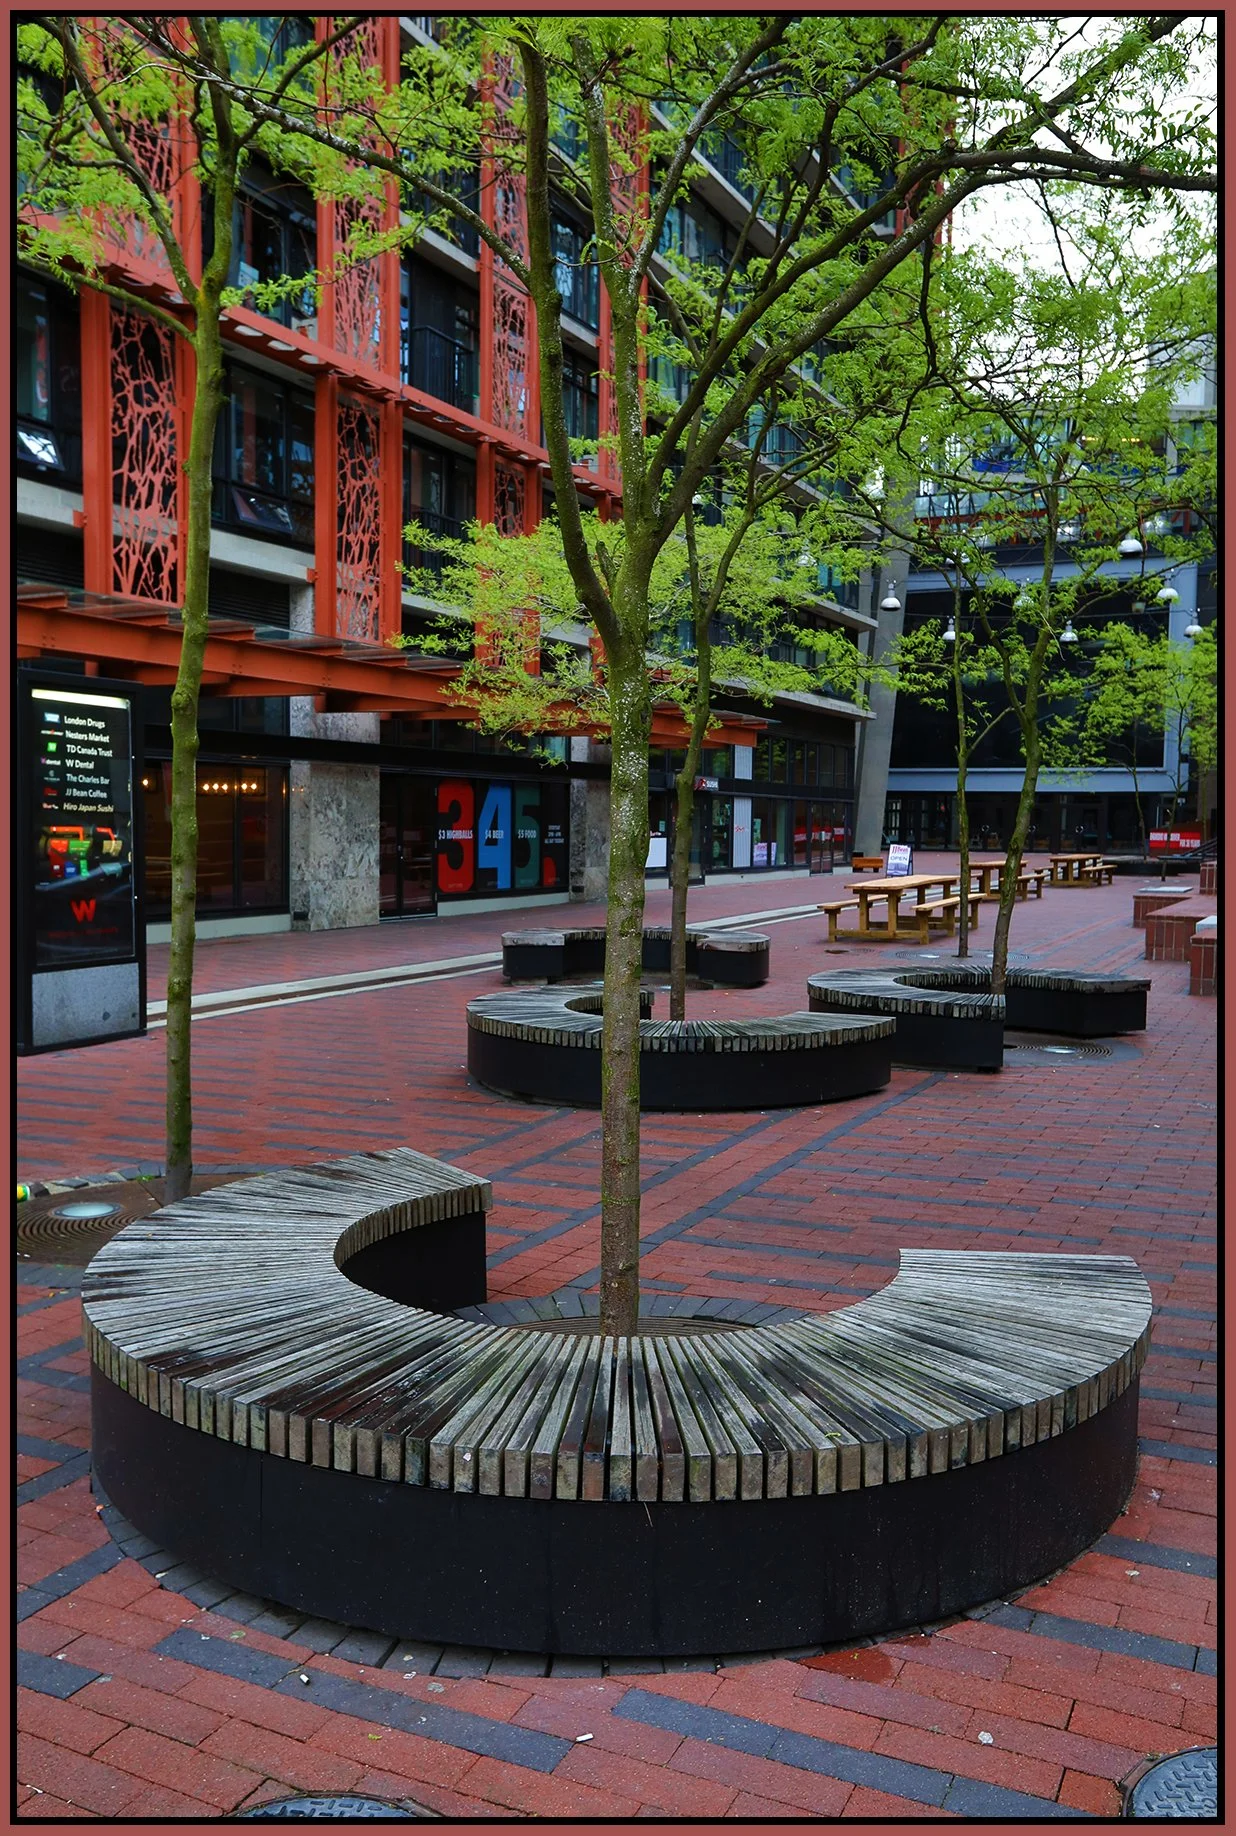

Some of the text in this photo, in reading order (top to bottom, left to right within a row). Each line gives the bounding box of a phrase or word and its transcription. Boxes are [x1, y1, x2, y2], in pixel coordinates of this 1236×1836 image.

[64, 716, 86, 725] London
[88, 718, 105, 729] Drugs
[66, 731, 88, 741] Nesters
[89, 734, 110, 743] Market
[67, 745, 112, 757] TD Canada Trust
[66, 759, 94, 768] W Dental
[78, 775, 99, 784] Charles
[100, 776, 110, 784] Bar
[66, 788, 71, 796] JJ
[72, 788, 87, 797] Bean
[88, 789, 107, 798] Coffee
[63, 803, 77, 811] Hiro
[78, 804, 97, 813] Japan
[98, 804, 114, 812] Sushi
[438, 829, 473, 840] $3 HIGHBALLS
[438, 779, 474, 893] 3
[478, 781, 511, 889] 4
[485, 830, 504, 839] $4 BEER
[514, 782, 541, 888] 5
[525, 830, 536, 839] FOOD
[70, 898, 97, 924] W
